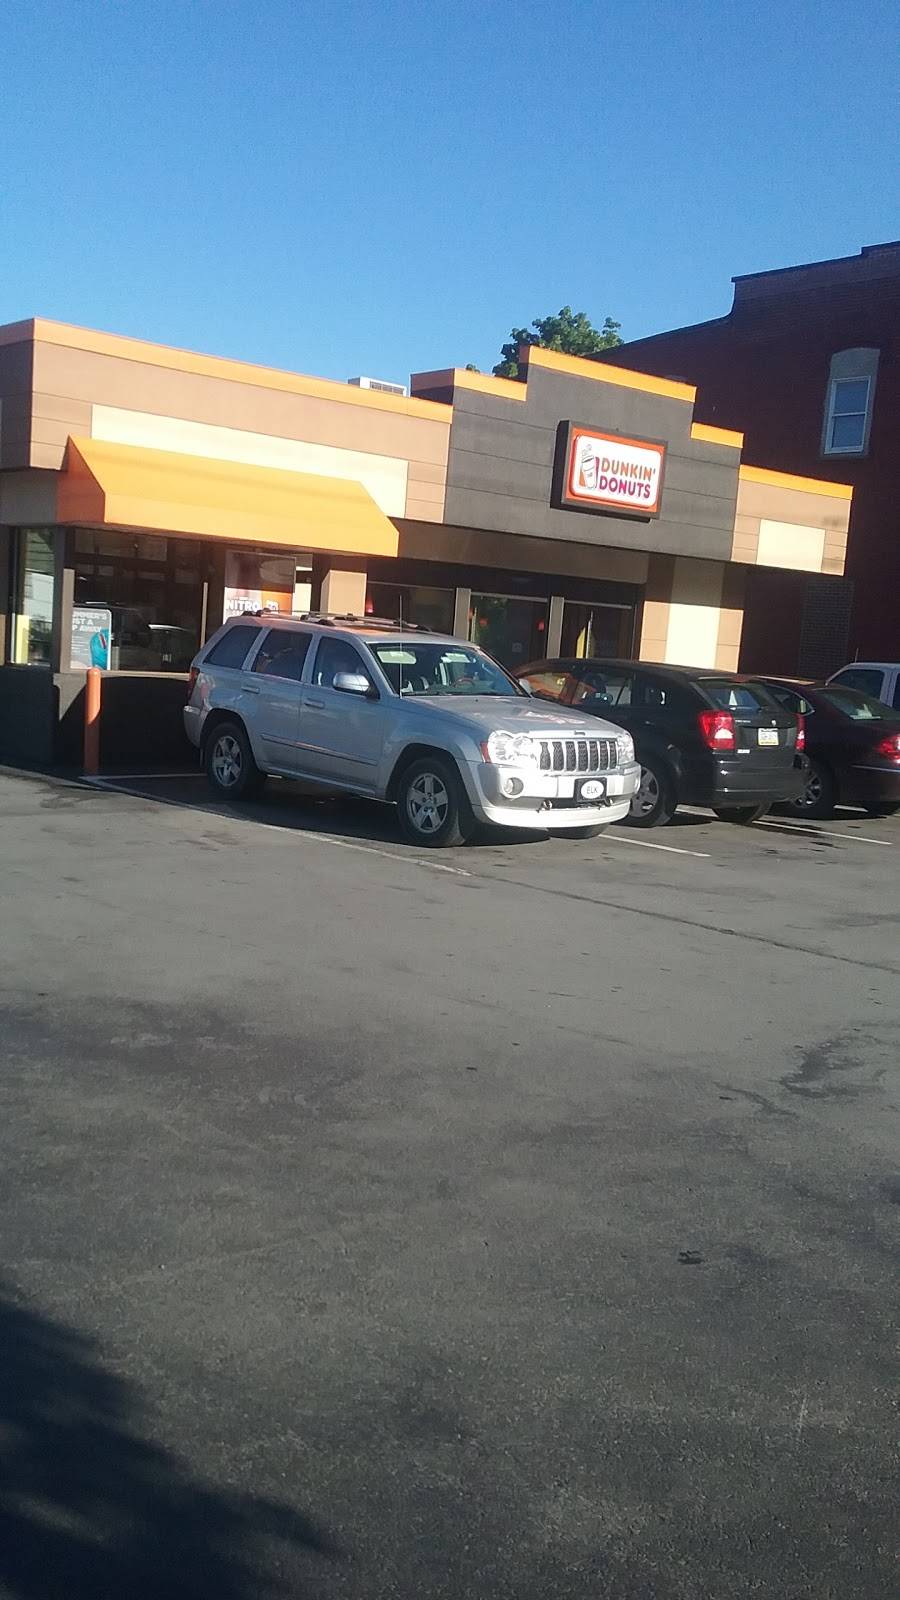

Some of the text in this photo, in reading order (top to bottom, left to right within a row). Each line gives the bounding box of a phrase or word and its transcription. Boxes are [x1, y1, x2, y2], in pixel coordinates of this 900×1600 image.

[601, 457, 656, 482] DUNKIN'
[599, 475, 651, 499] DONUTS
[227, 600, 259, 612] NITRO
[586, 785, 599, 795] ELK
